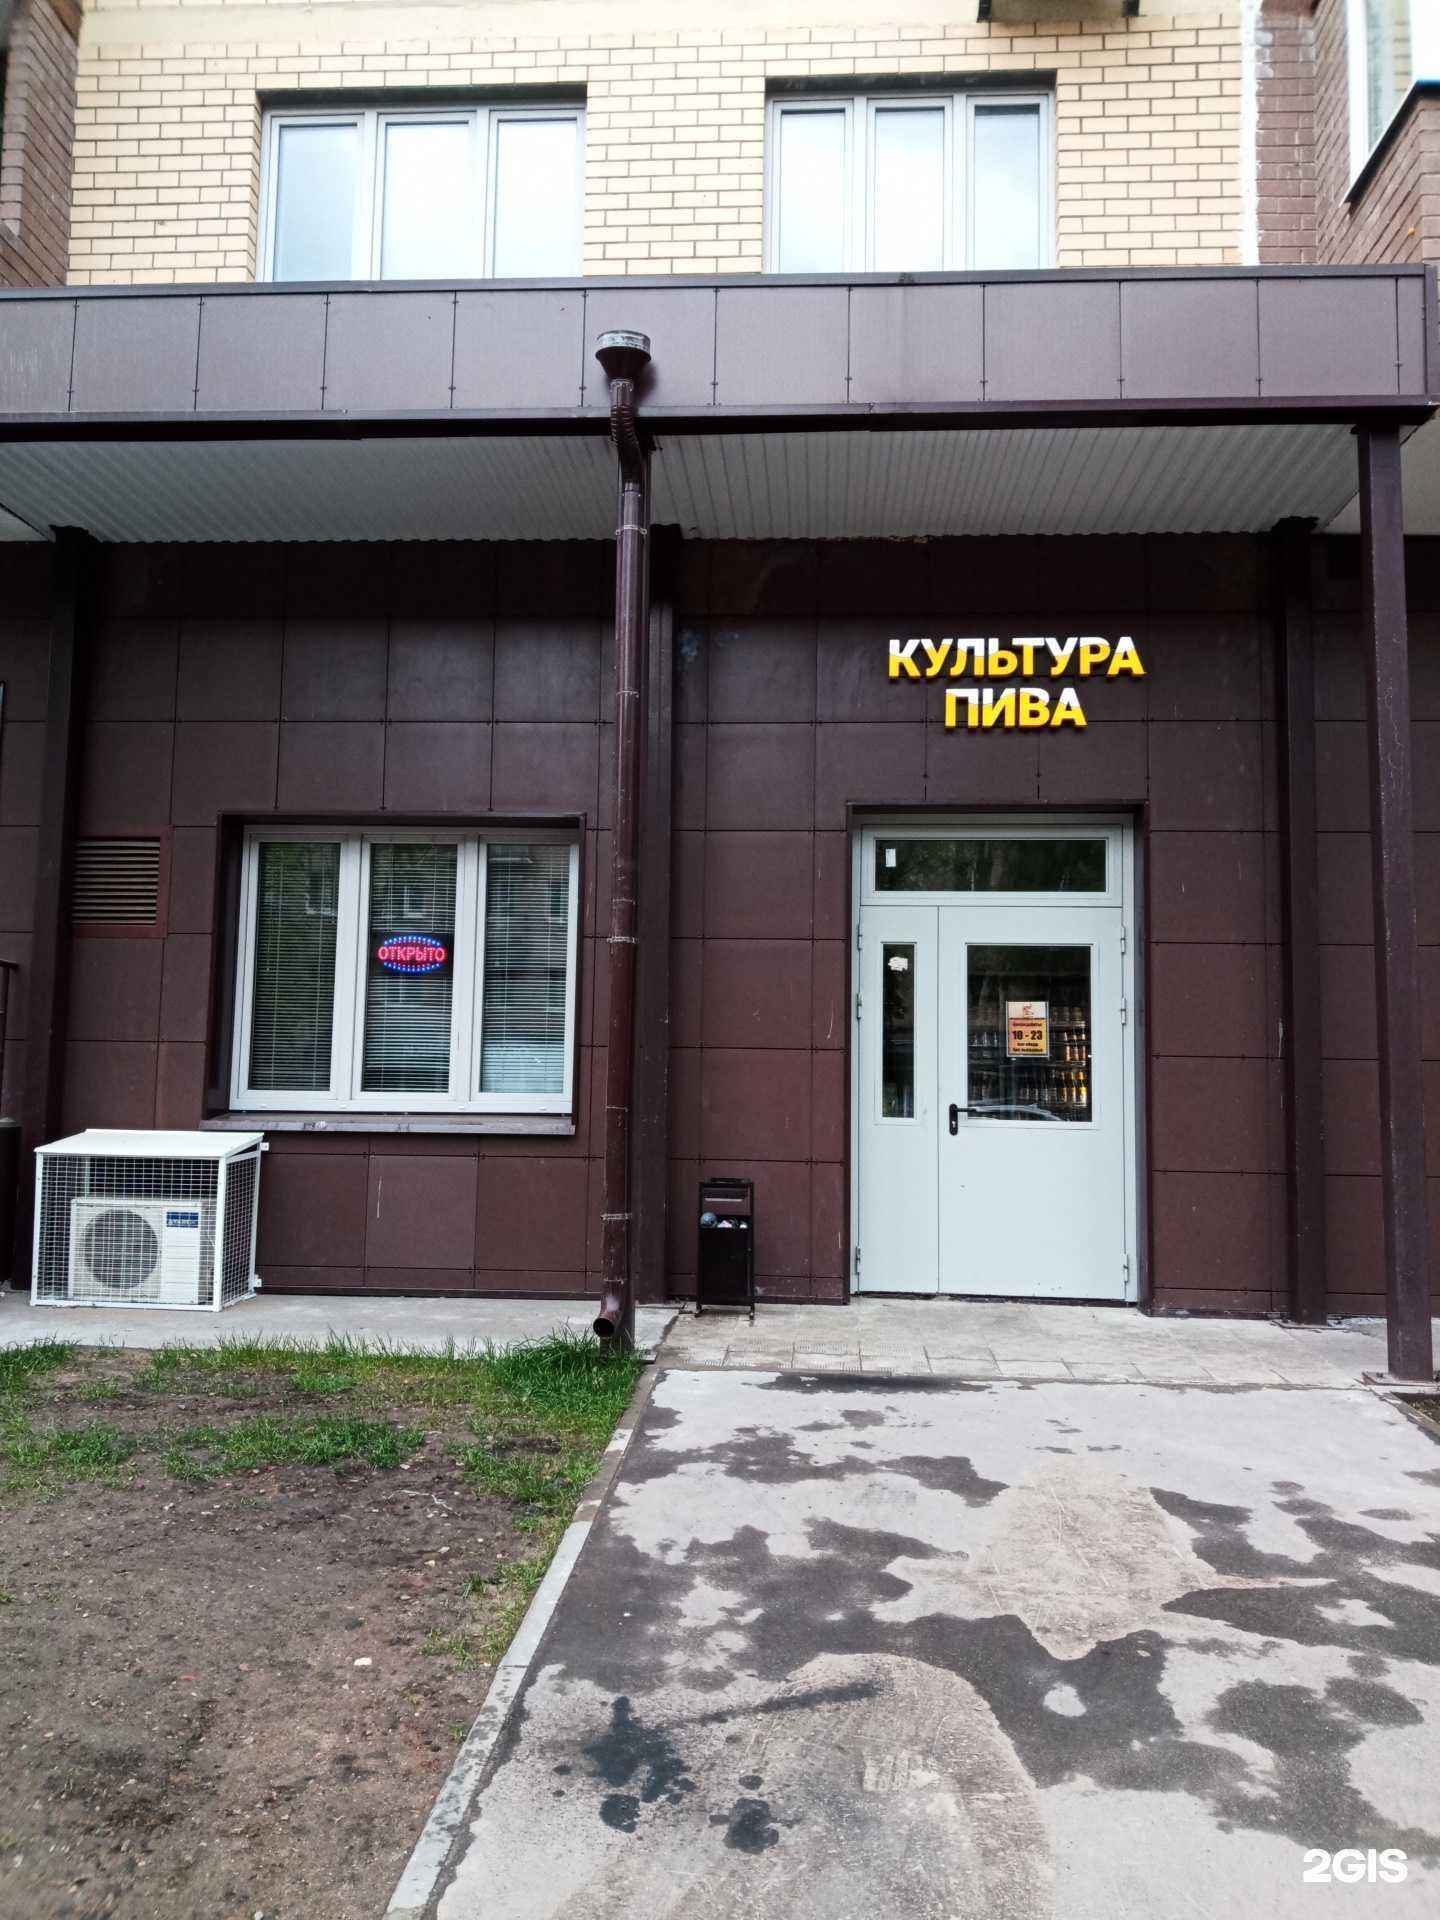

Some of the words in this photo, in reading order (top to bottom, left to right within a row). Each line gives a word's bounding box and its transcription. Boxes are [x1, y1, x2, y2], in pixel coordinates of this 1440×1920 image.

[888, 636, 1146, 677] КУЛЬТУРА
[944, 687, 1088, 727] ПИВА
[378, 946, 445, 961] ОТКРЫТО
